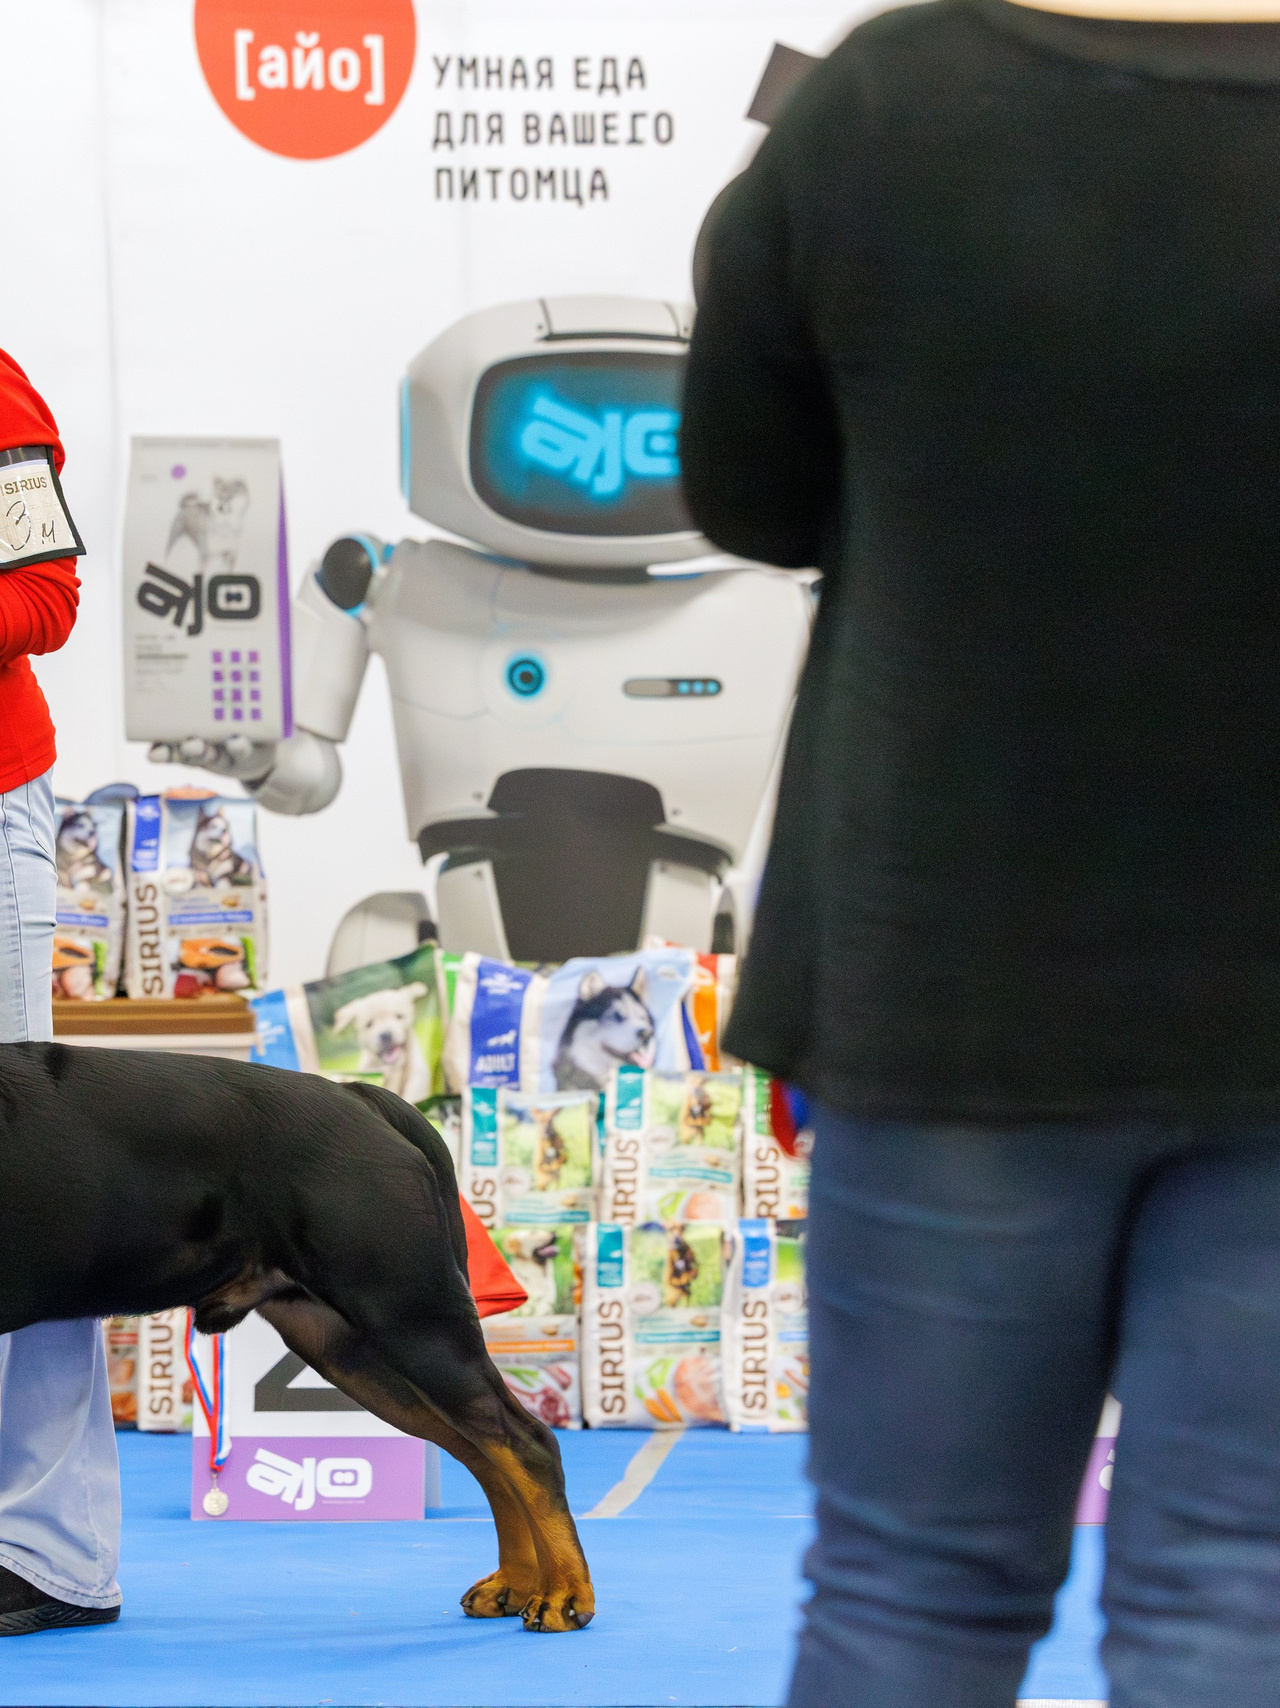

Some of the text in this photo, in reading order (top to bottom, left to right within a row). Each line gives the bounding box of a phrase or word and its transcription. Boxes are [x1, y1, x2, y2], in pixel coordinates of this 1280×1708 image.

[433, 55, 647, 96] УМНАЯ ЕДА
[432, 112, 677, 151] ДЛЯ ВАШЕГО
[434, 167, 611, 207] ПИТОМЦА
[4, 477, 47, 495] SIRIUS
[136, 883, 164, 995] SIRIUS
[611, 1139, 639, 1227] IRIUS
[756, 1147, 780, 1219] RIUS
[149, 1312, 173, 1415] SIRIU
[598, 1300, 626, 1413] SIRIUS
[742, 1300, 768, 1409] SIRIUS
